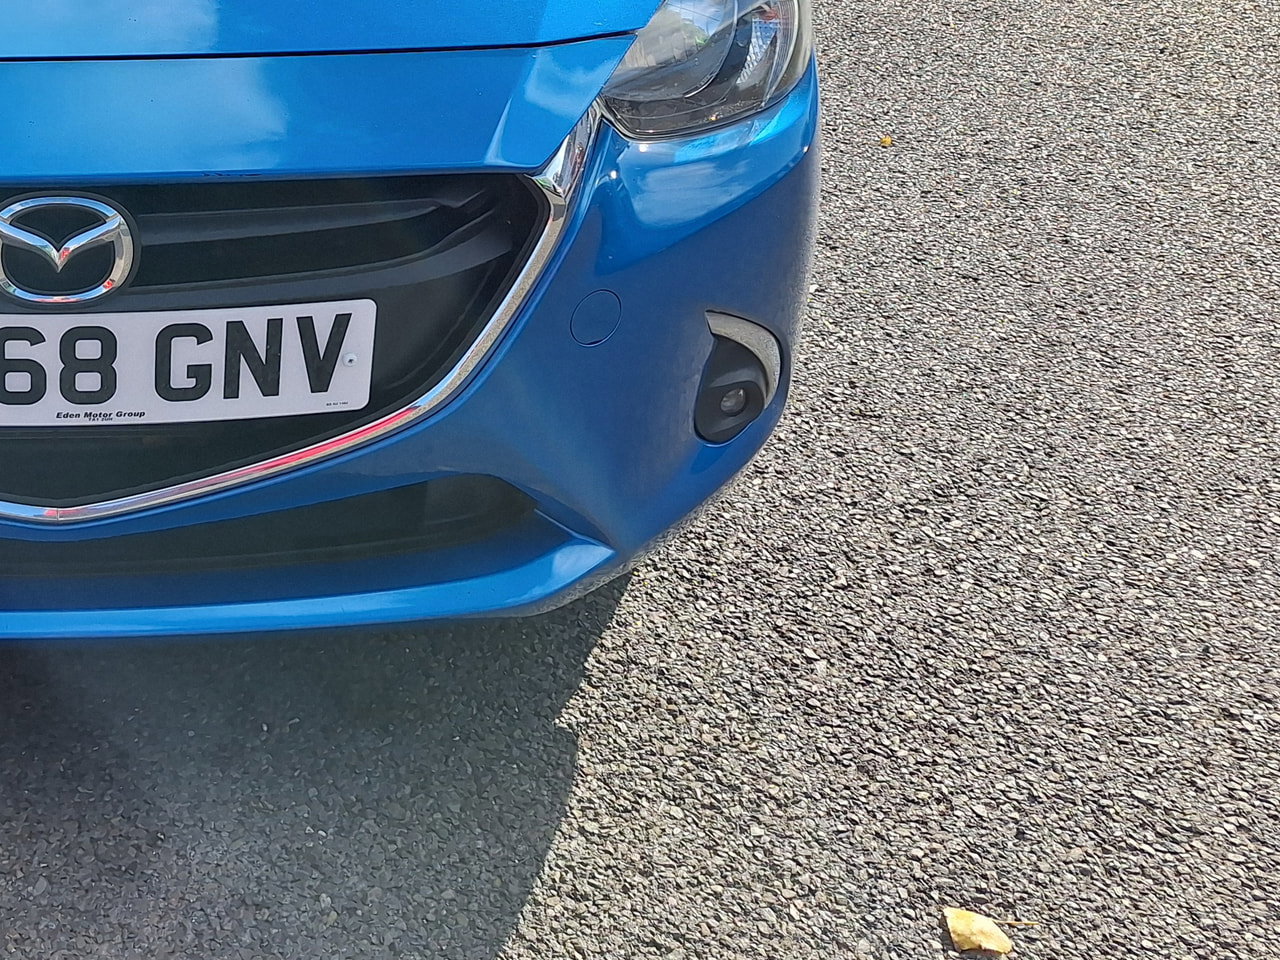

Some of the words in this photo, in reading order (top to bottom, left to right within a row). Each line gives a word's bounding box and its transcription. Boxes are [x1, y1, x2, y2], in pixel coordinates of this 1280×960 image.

[154, 313, 353, 402] GNV
[55, 411, 81, 419] Eden
[83, 411, 113, 419] Motor
[115, 410, 146, 418] Group
